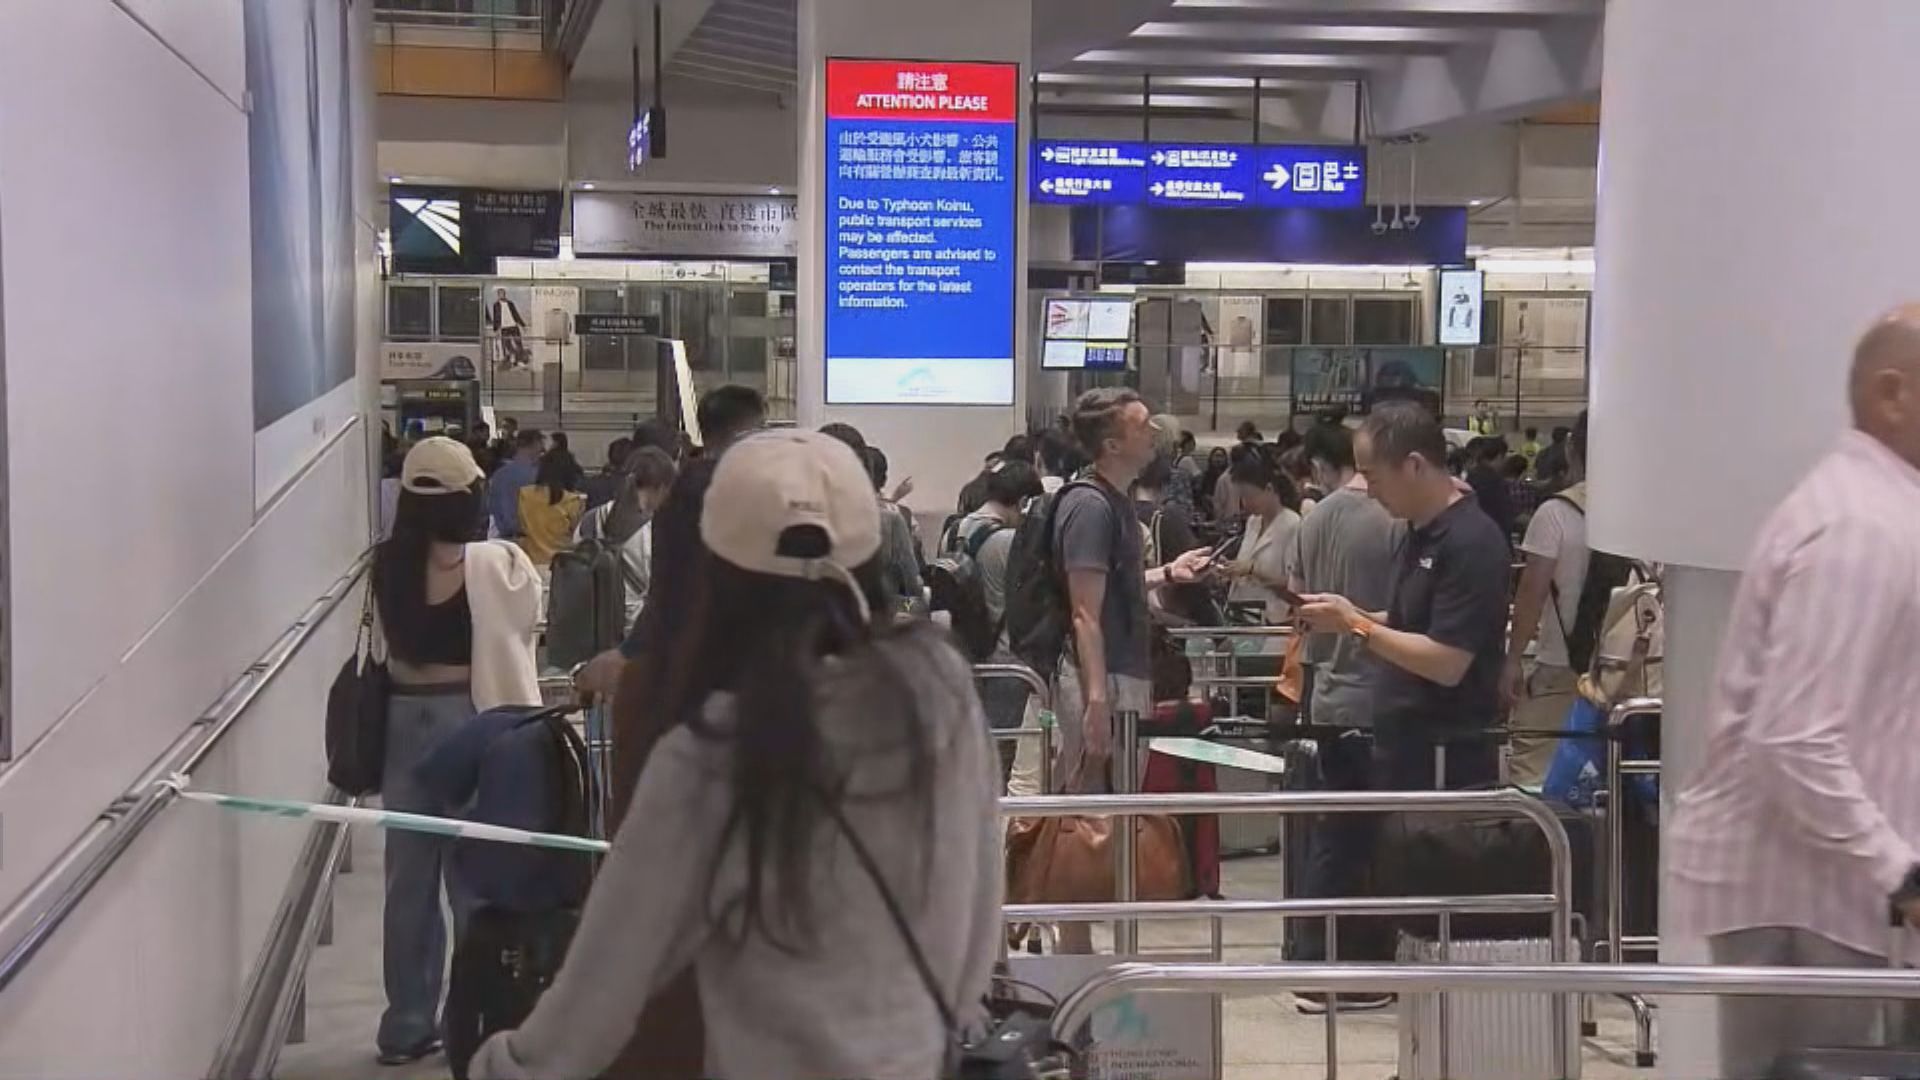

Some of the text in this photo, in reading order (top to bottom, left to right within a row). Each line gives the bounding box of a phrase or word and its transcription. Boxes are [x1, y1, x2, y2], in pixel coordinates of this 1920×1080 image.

[897, 72, 948, 91] 請注意
[857, 94, 988, 111] ATTENTION PLEASE
[1323, 161, 1359, 180] 巴士
[839, 197, 974, 212] Due to Typhoon Koinu,
[645, 221, 781, 233] The fastest link to the city
[839, 214, 982, 228] public transport services
[839, 231, 937, 244] may be affected.
[839, 247, 996, 261] Passengers are advised to
[839, 264, 960, 277] contact the transport
[839, 280, 972, 293] operators for the latest
[839, 295, 908, 308] information.
